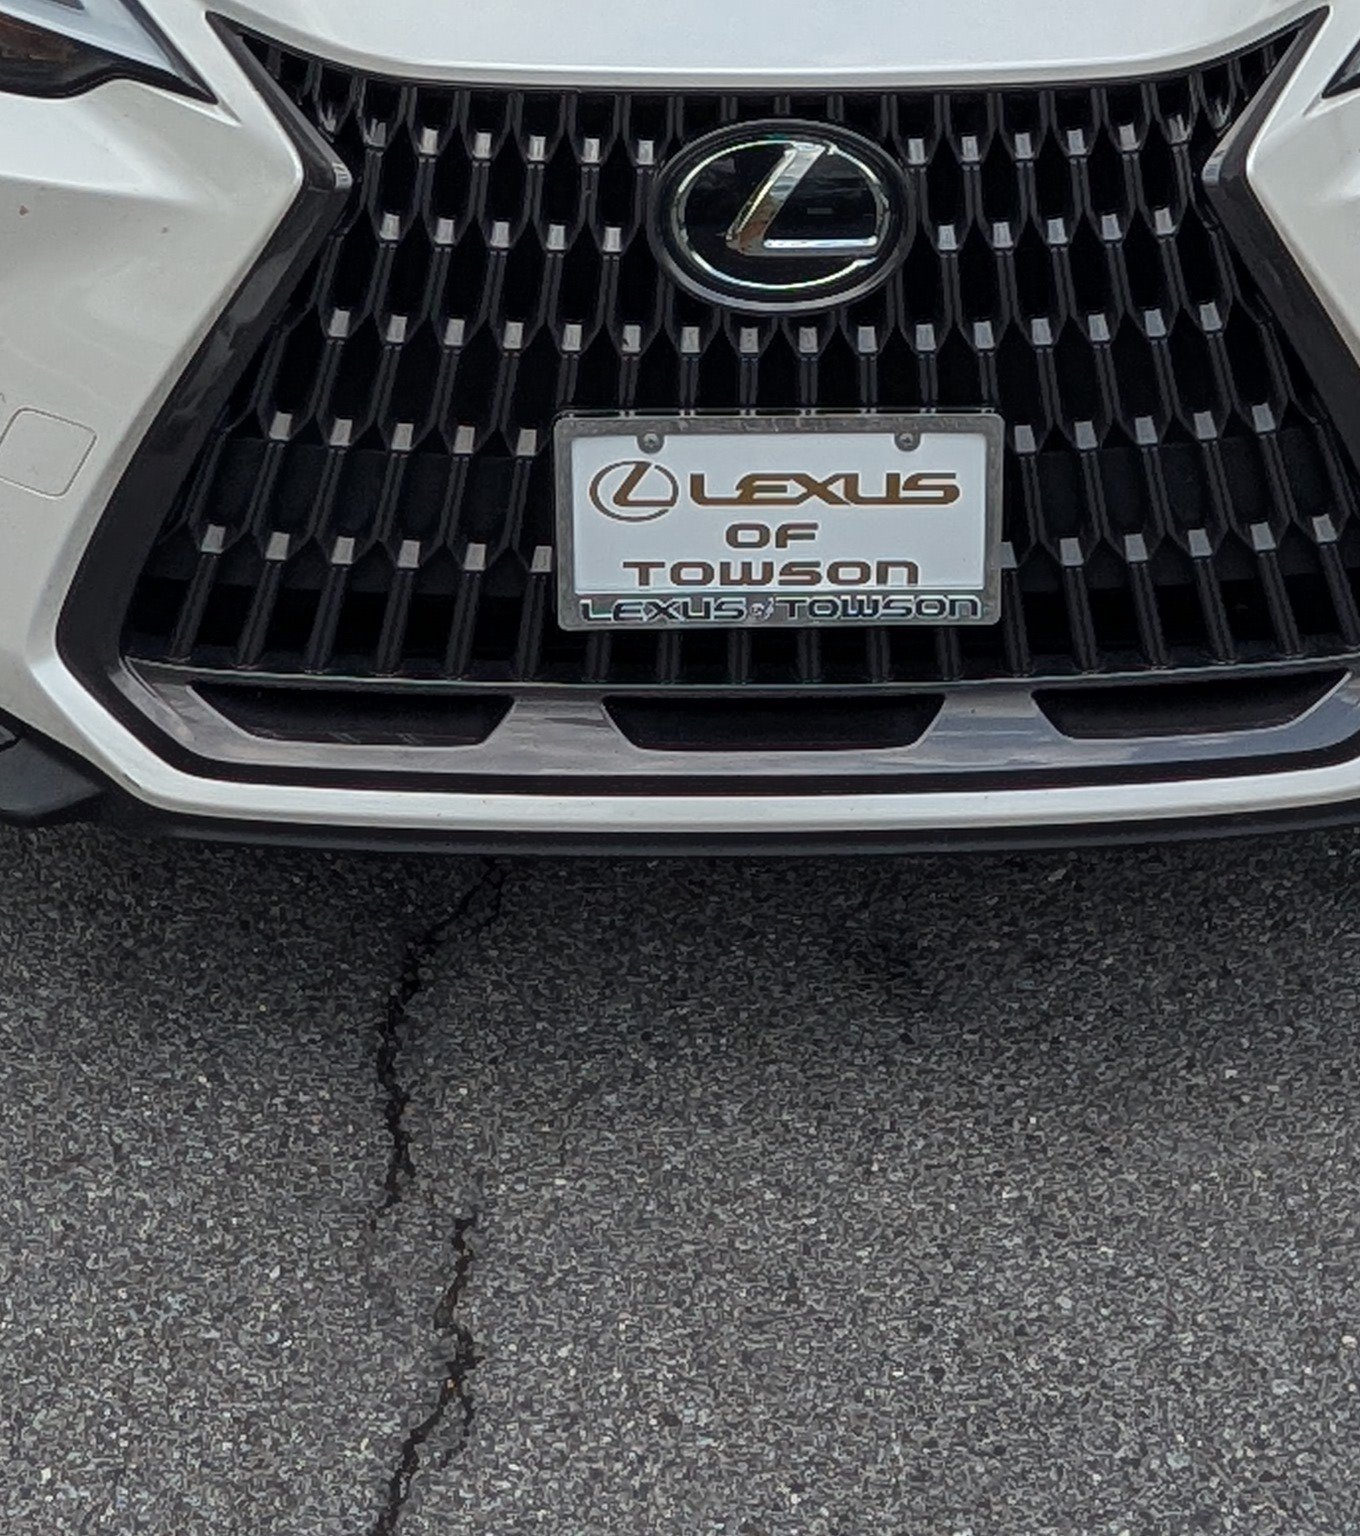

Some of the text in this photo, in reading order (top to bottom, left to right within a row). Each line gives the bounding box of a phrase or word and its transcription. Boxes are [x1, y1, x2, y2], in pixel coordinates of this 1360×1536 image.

[689, 472, 960, 506] LEXUS
[725, 522, 819, 549] OF
[622, 560, 919, 586] TOWSON
[580, 596, 747, 622] LEXUS
[774, 594, 980, 620] TOWSON
